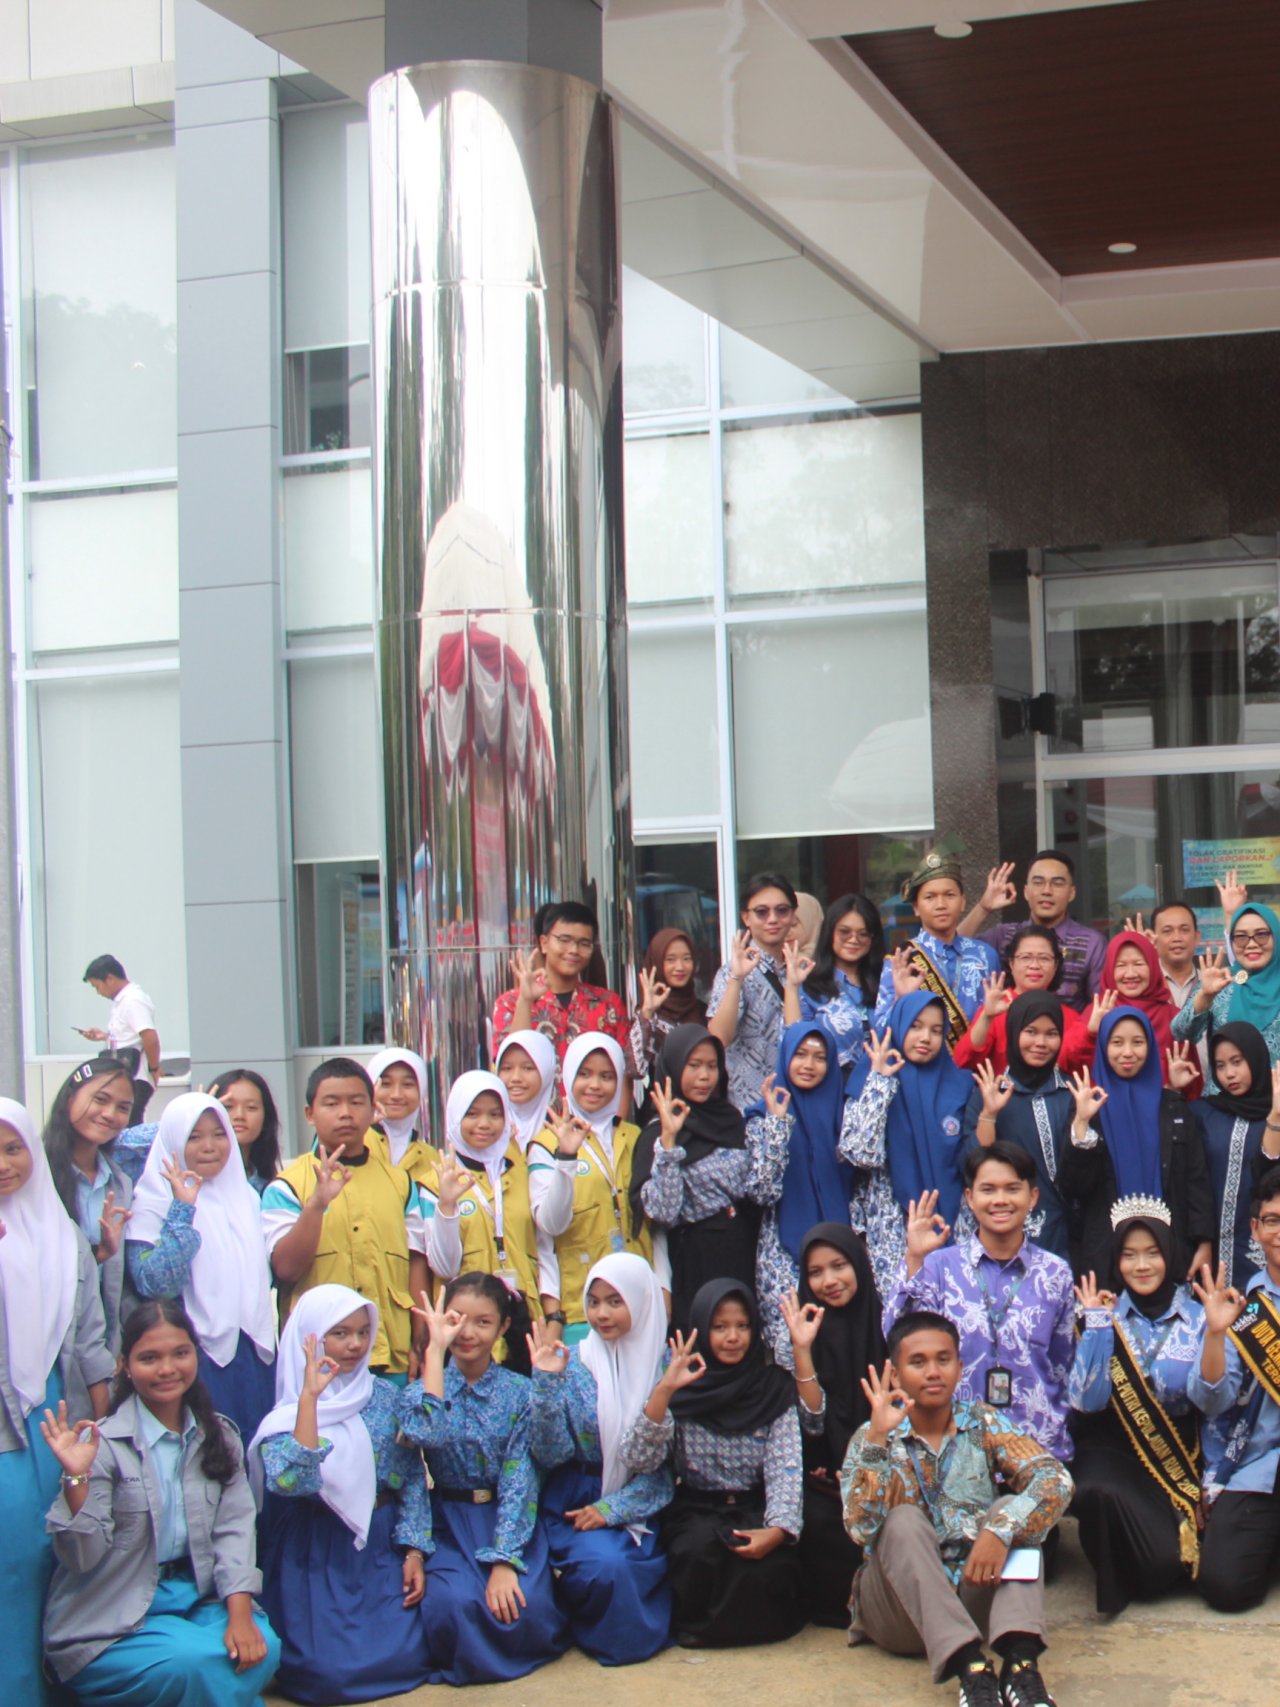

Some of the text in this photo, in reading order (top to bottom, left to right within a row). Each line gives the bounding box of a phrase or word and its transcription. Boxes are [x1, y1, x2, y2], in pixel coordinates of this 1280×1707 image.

[1189, 857, 1210, 865] DAN
[1217, 848, 1266, 856] GRATIFIKASI
[1251, 1319, 1278, 1348] DUTA
[1120, 1382, 1143, 1413] PUTRI
[1132, 1407, 1173, 1462] KEPULAUAN
[1162, 1454, 1187, 1481] RIAU
